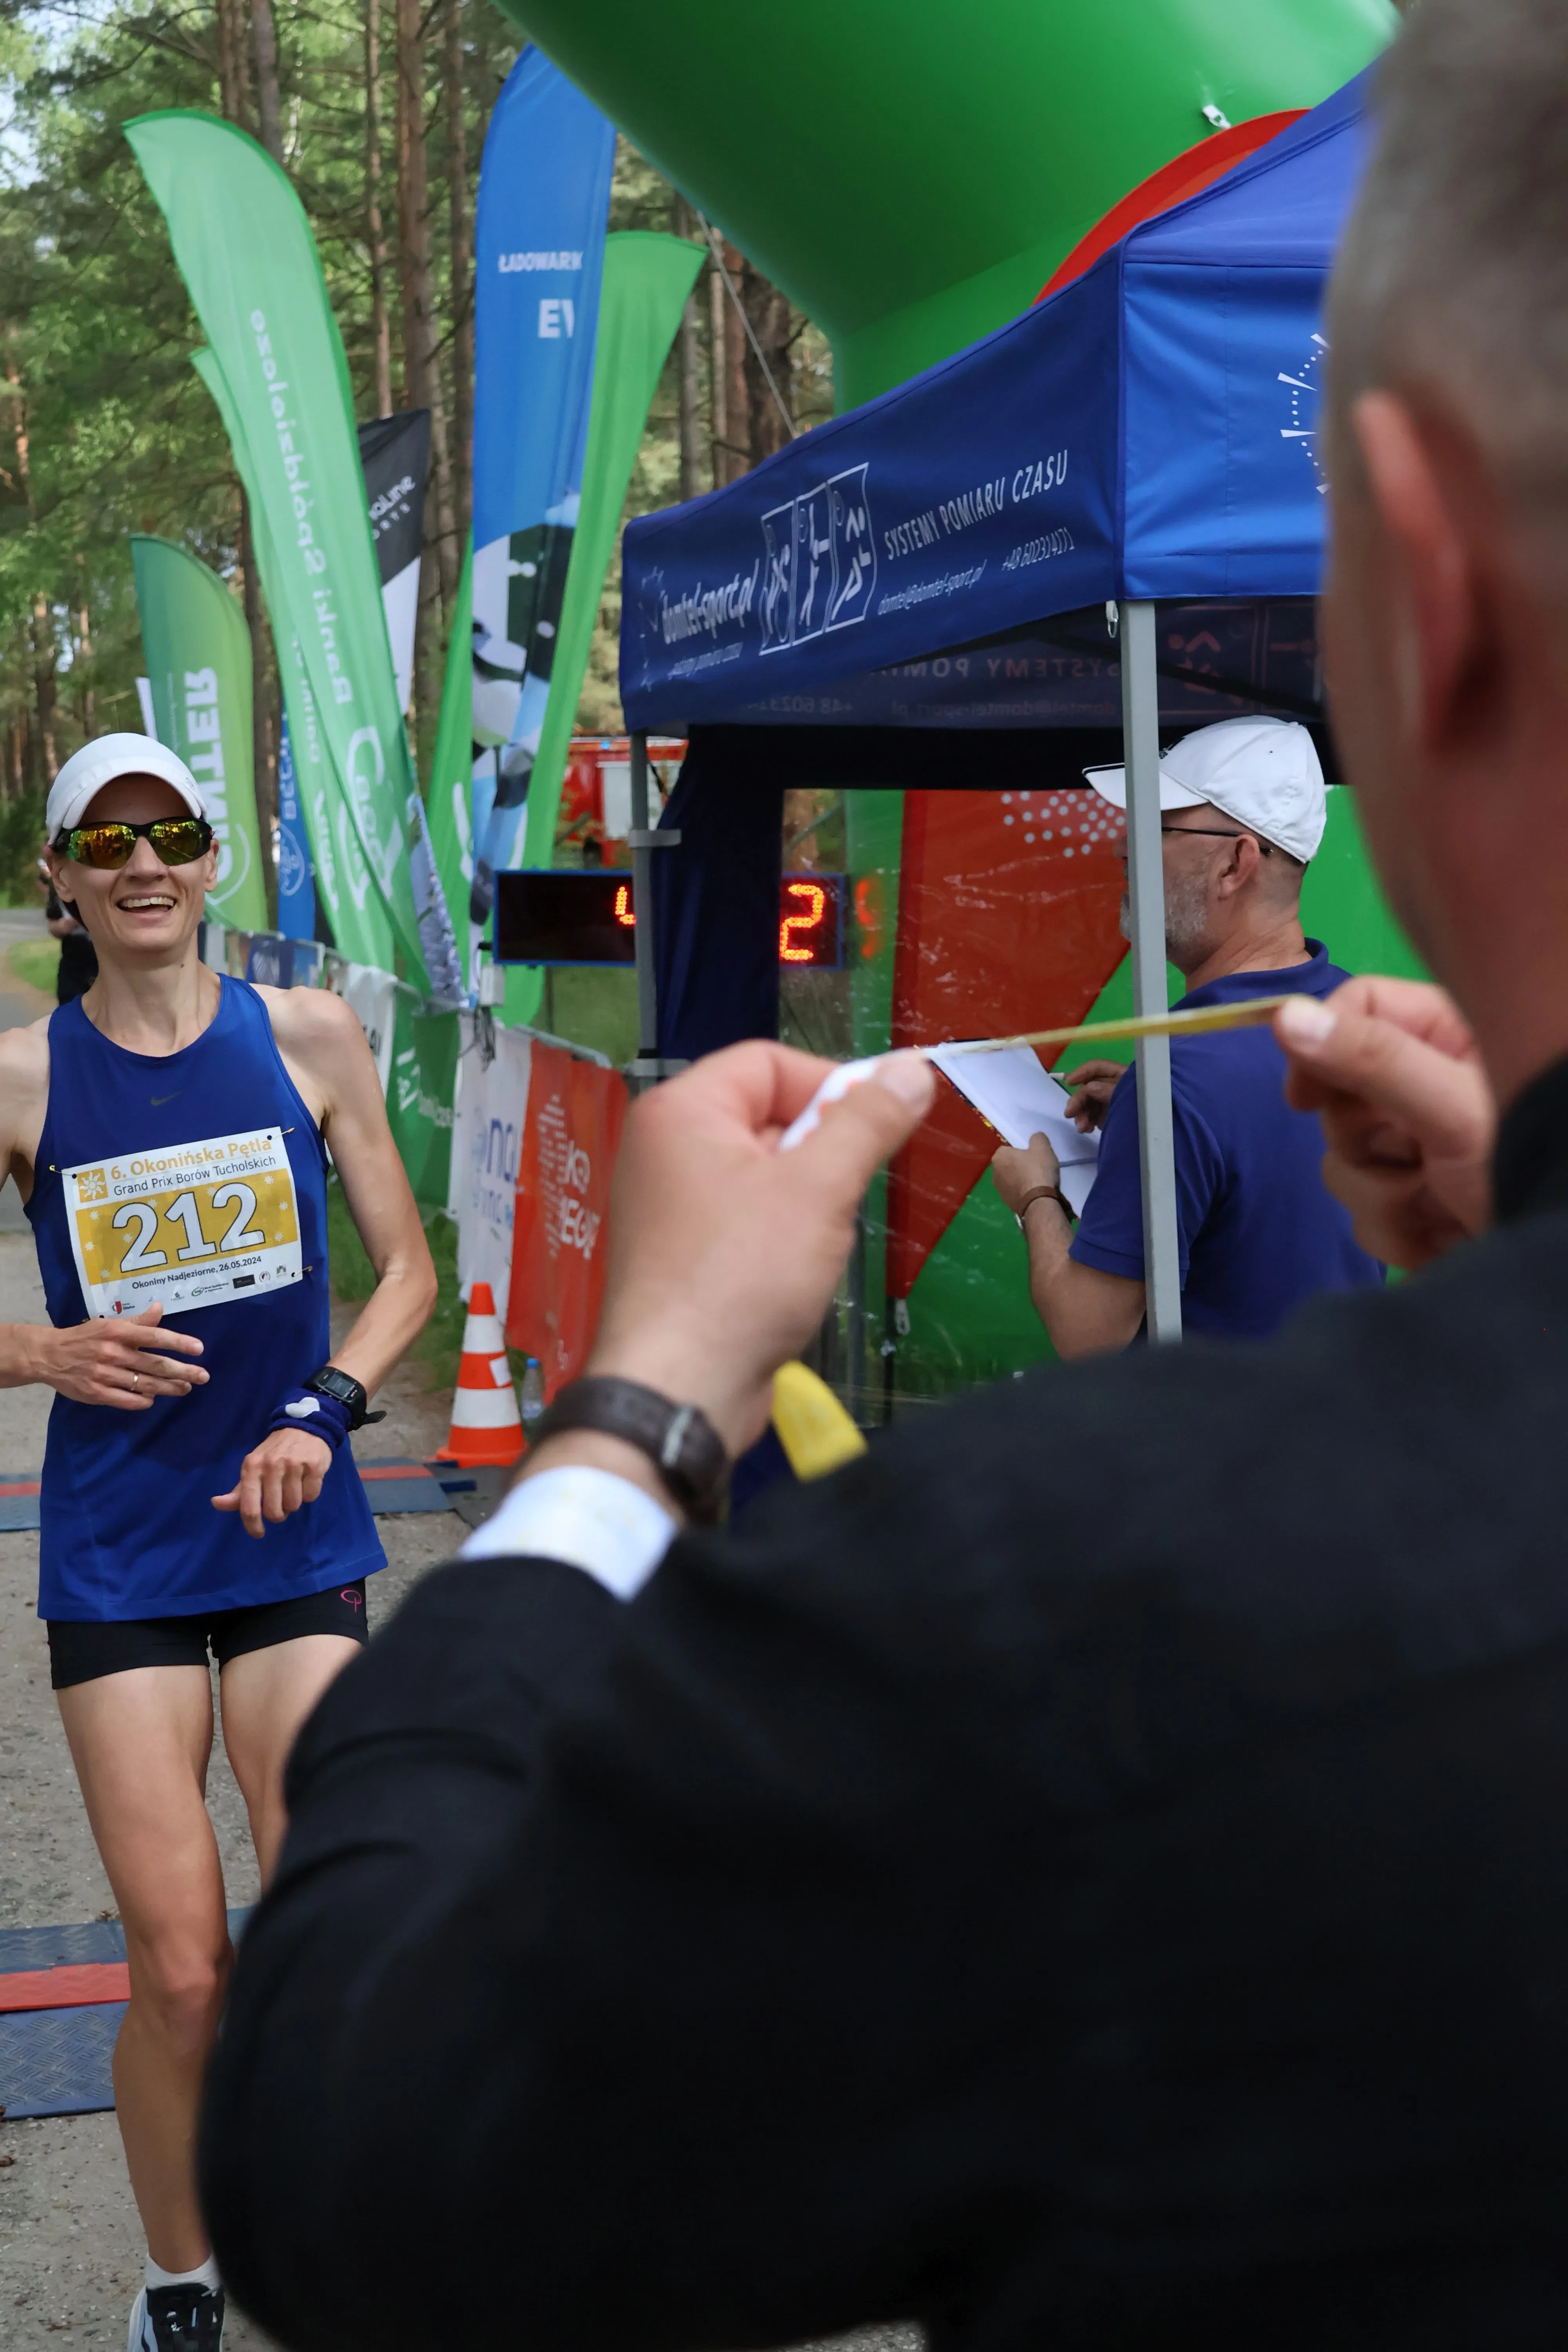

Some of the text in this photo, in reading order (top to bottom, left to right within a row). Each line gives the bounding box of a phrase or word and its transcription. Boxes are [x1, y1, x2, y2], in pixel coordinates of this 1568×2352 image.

[884, 449, 1068, 561] SYSTEMY POMIARU CZASU
[111, 1138, 271, 1180] 6. Okonińska Pętla
[113, 1155, 277, 1196] Grand Prix Borów Tucholskich
[111, 1182, 266, 1273] 212
[132, 1255, 262, 1290] Okoniny Nadjeziorne, 26.05.2024
